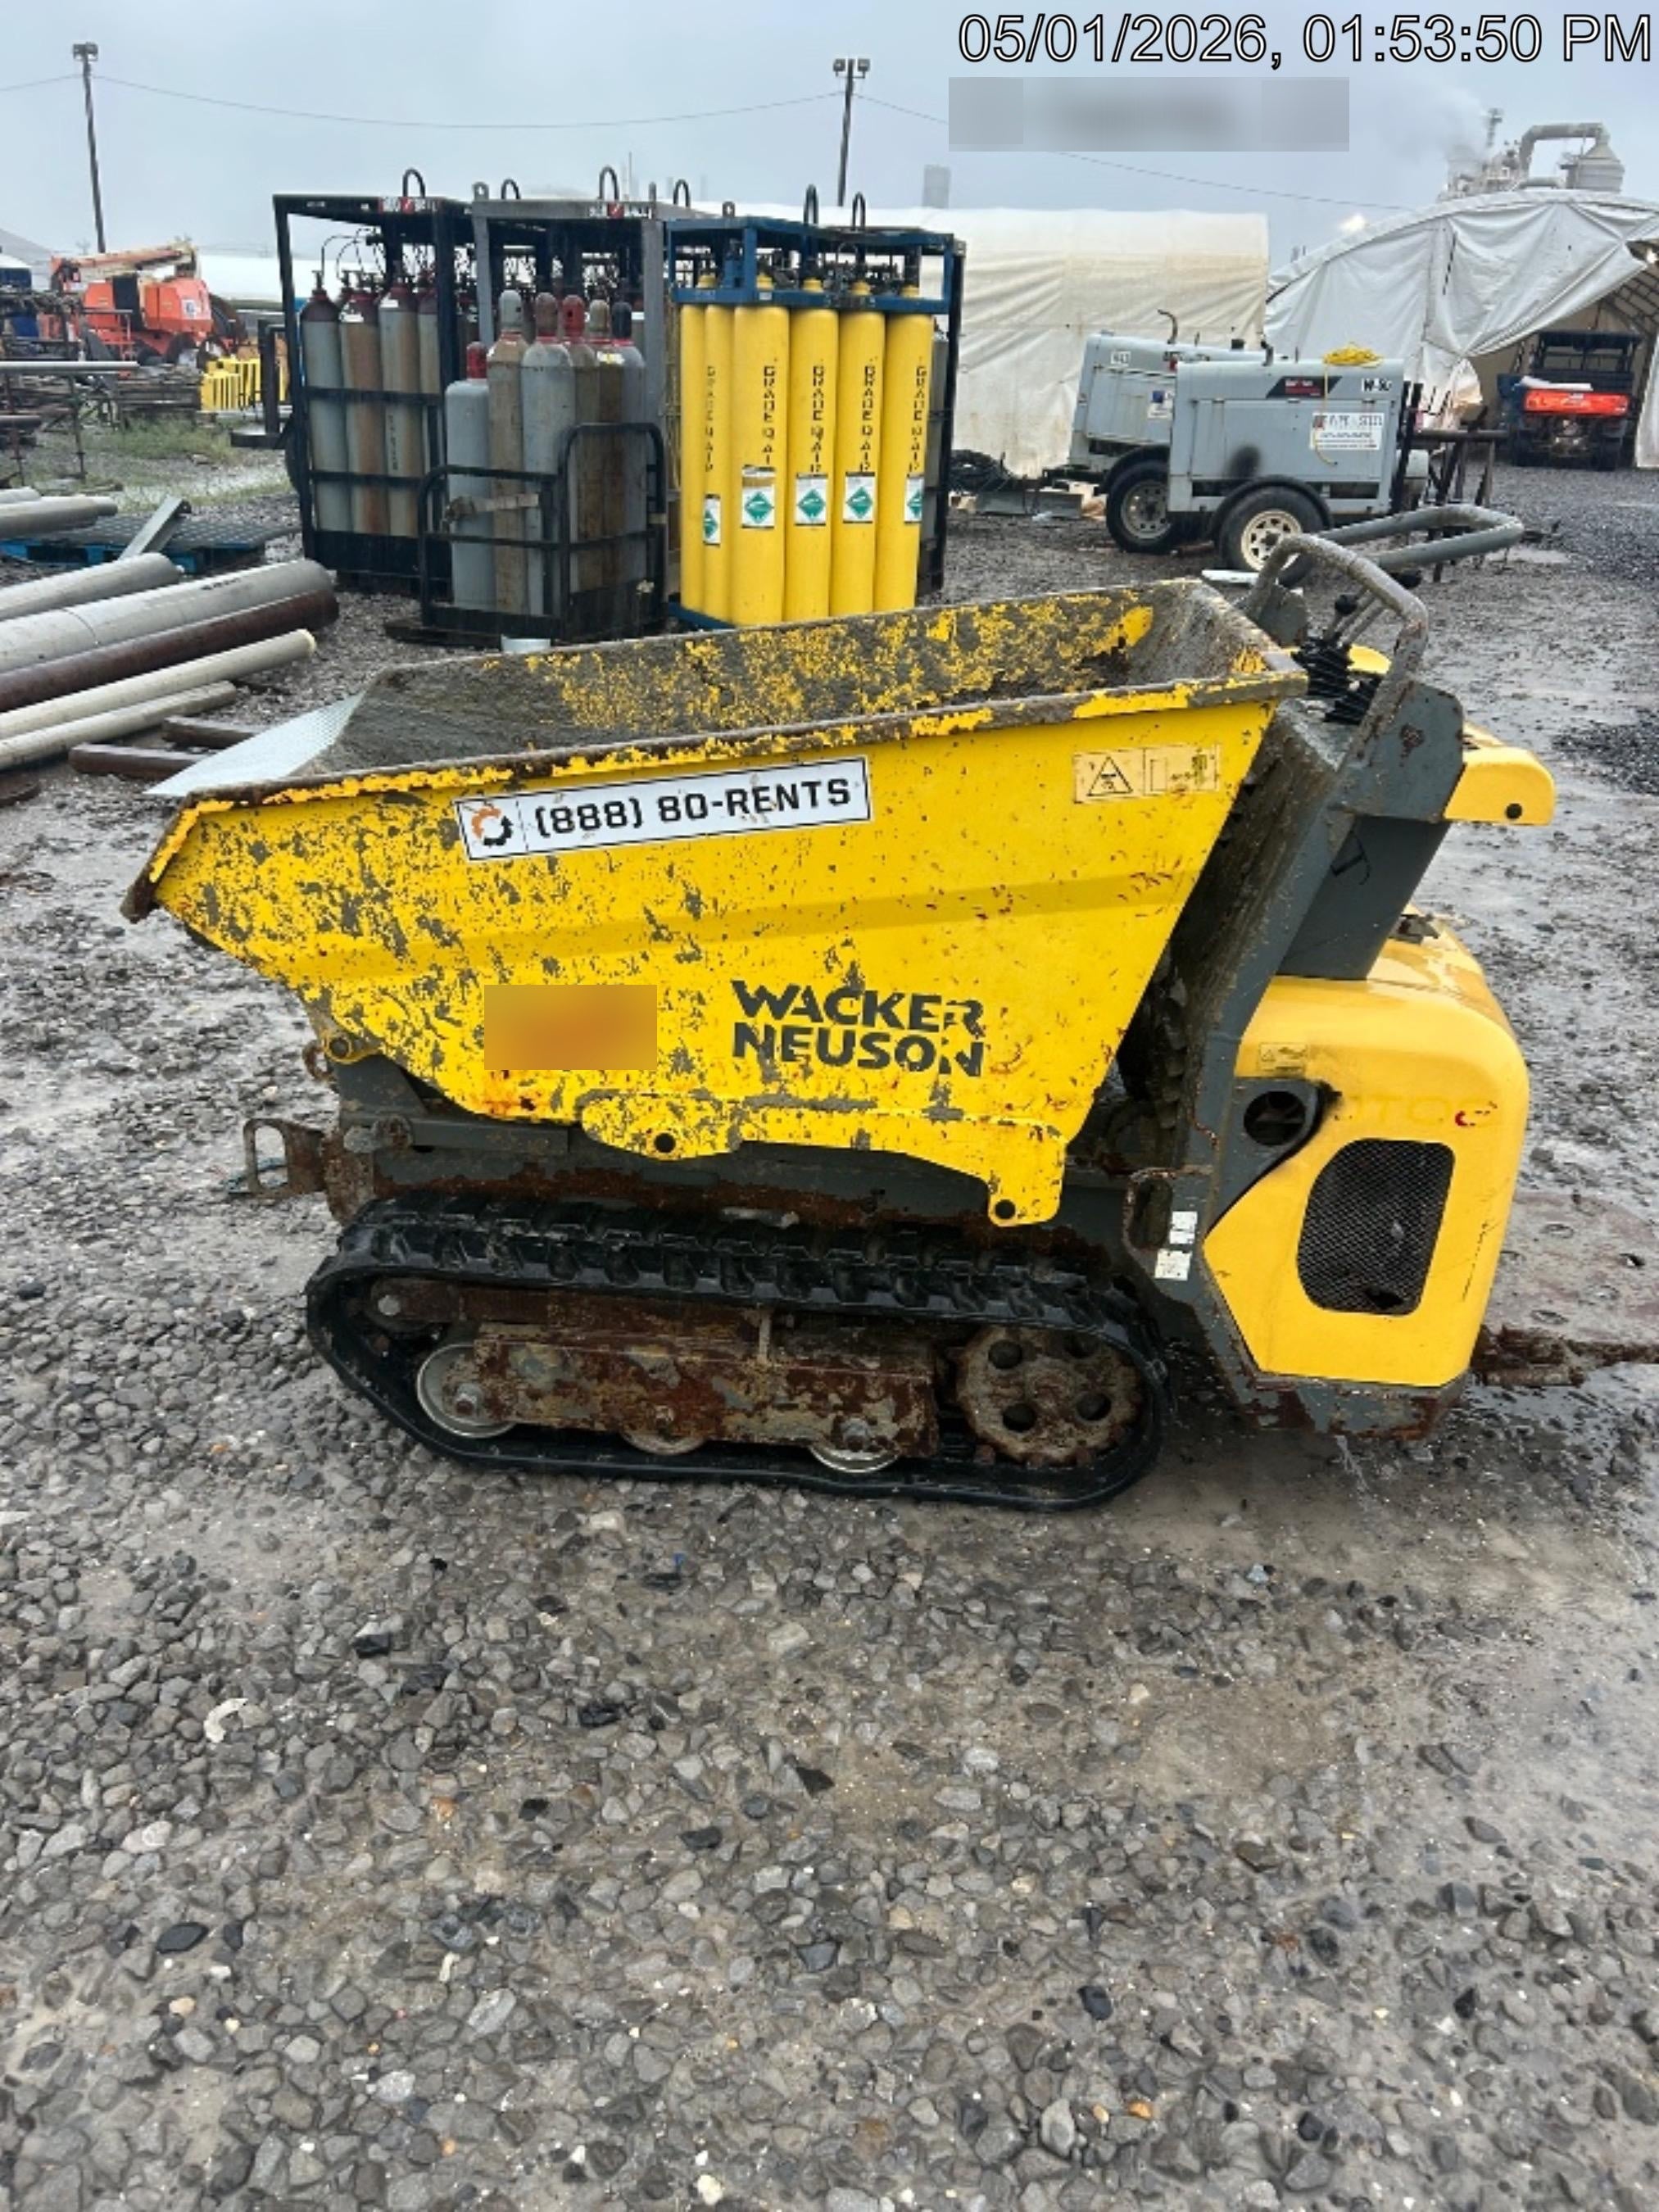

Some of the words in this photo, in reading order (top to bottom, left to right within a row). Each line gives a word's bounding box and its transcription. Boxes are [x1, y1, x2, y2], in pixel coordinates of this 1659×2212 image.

[535, 797, 643, 838] (888)
[658, 778, 852, 823] 80-RENTS
[730, 980, 986, 1039] WACKER
[732, 1022, 985, 1077] NEUSON
